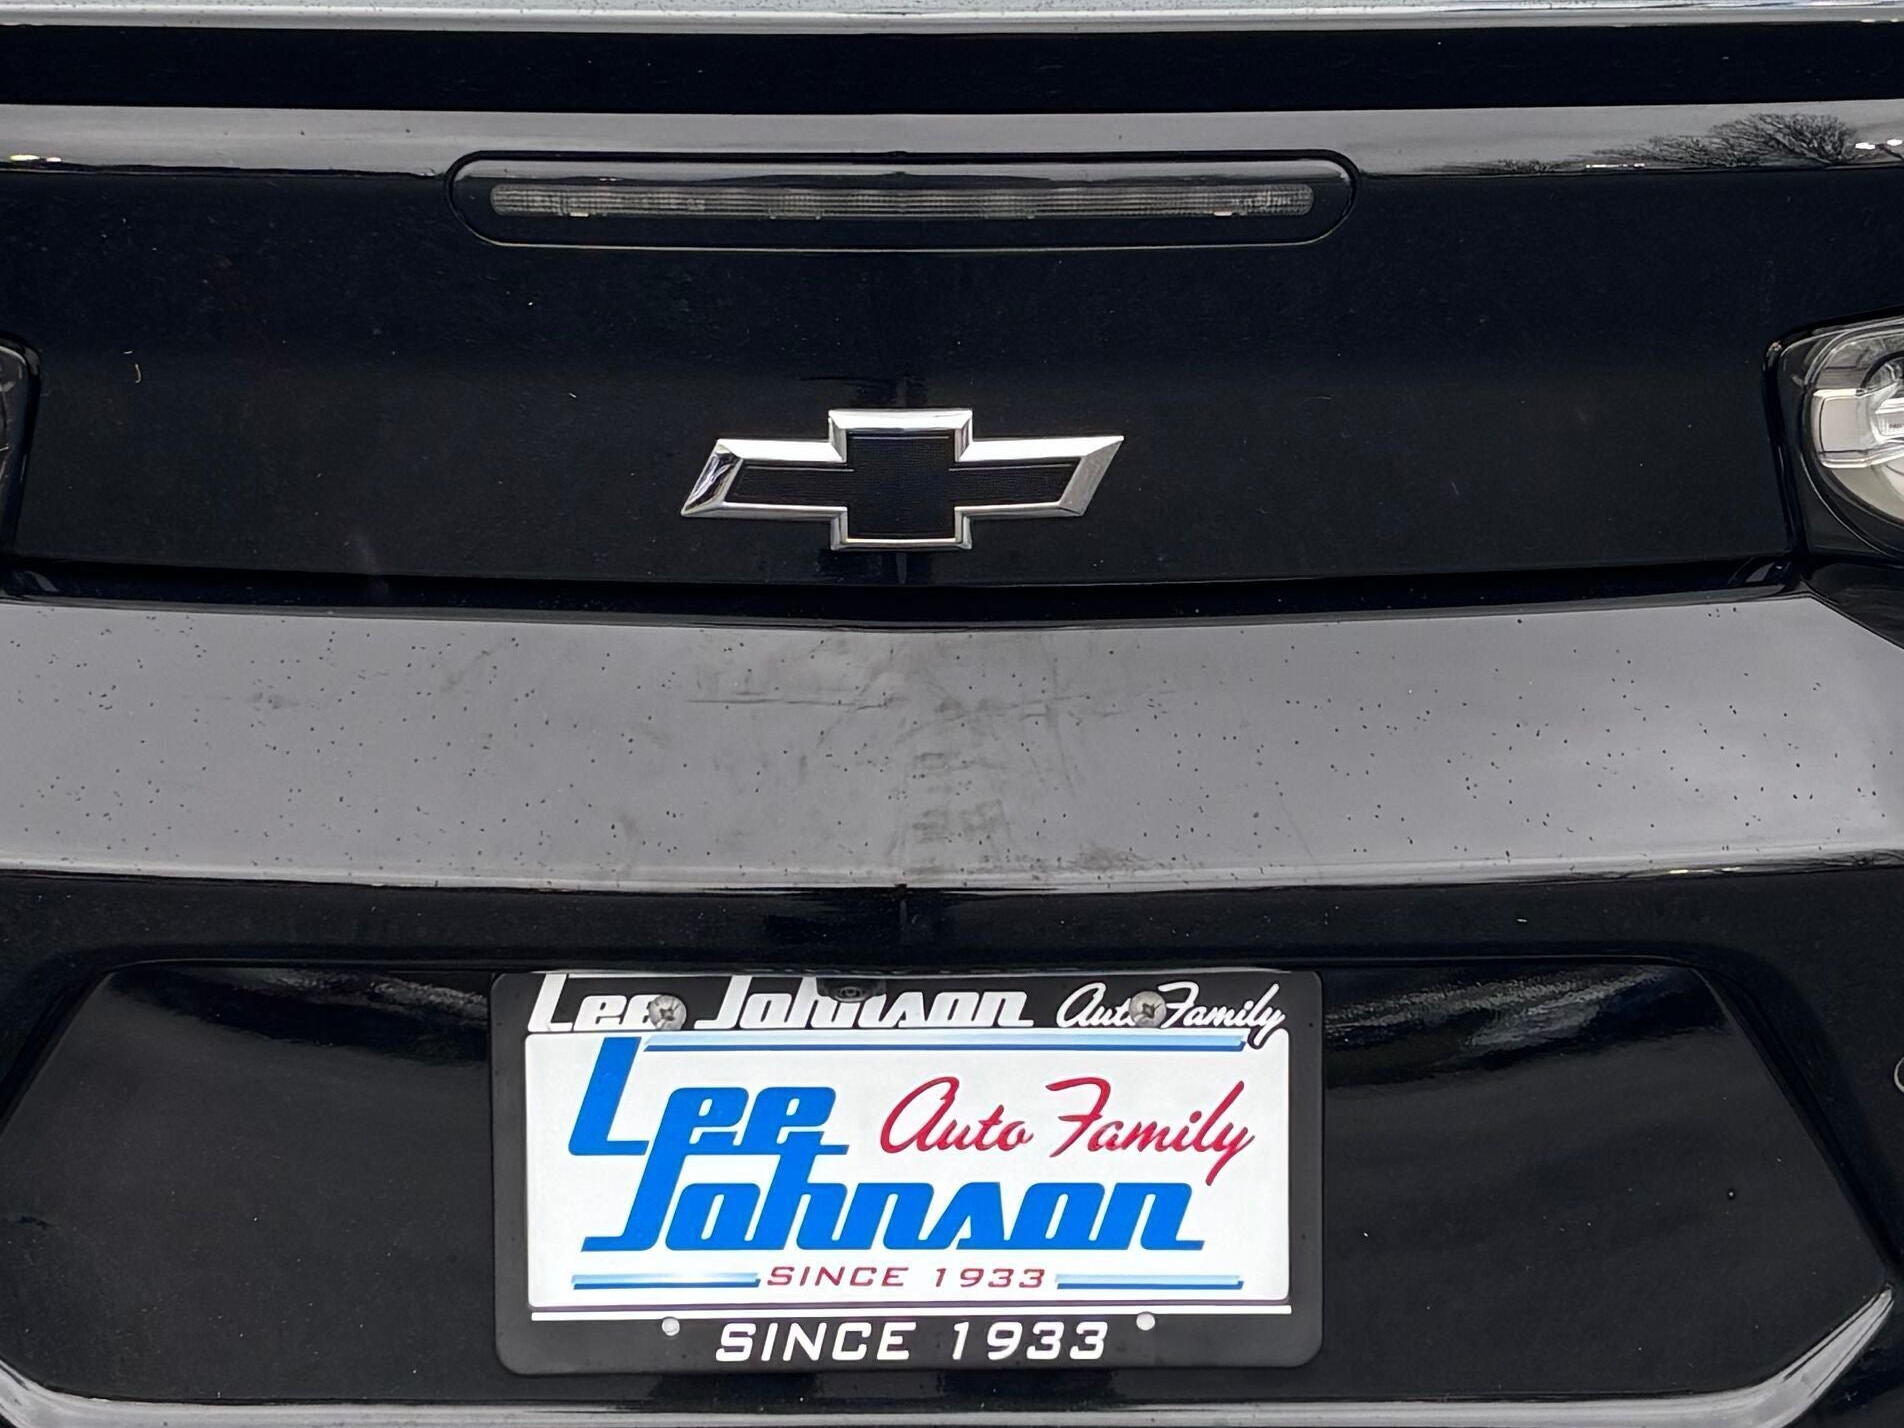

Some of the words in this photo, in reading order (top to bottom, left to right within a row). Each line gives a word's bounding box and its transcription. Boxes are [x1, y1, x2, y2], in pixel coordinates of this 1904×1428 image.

[1157, 980, 1287, 1049] Family
[567, 1036, 850, 1157] Lee
[879, 1076, 1034, 1159] Auto
[1045, 1077, 1256, 1187] Family
[580, 1146, 1206, 1253] Johnson
[766, 1266, 909, 1289] SINCE
[931, 1268, 1046, 1291] 1933
[714, 1320, 918, 1363] SINCE
[951, 1322, 1109, 1363] 1933
